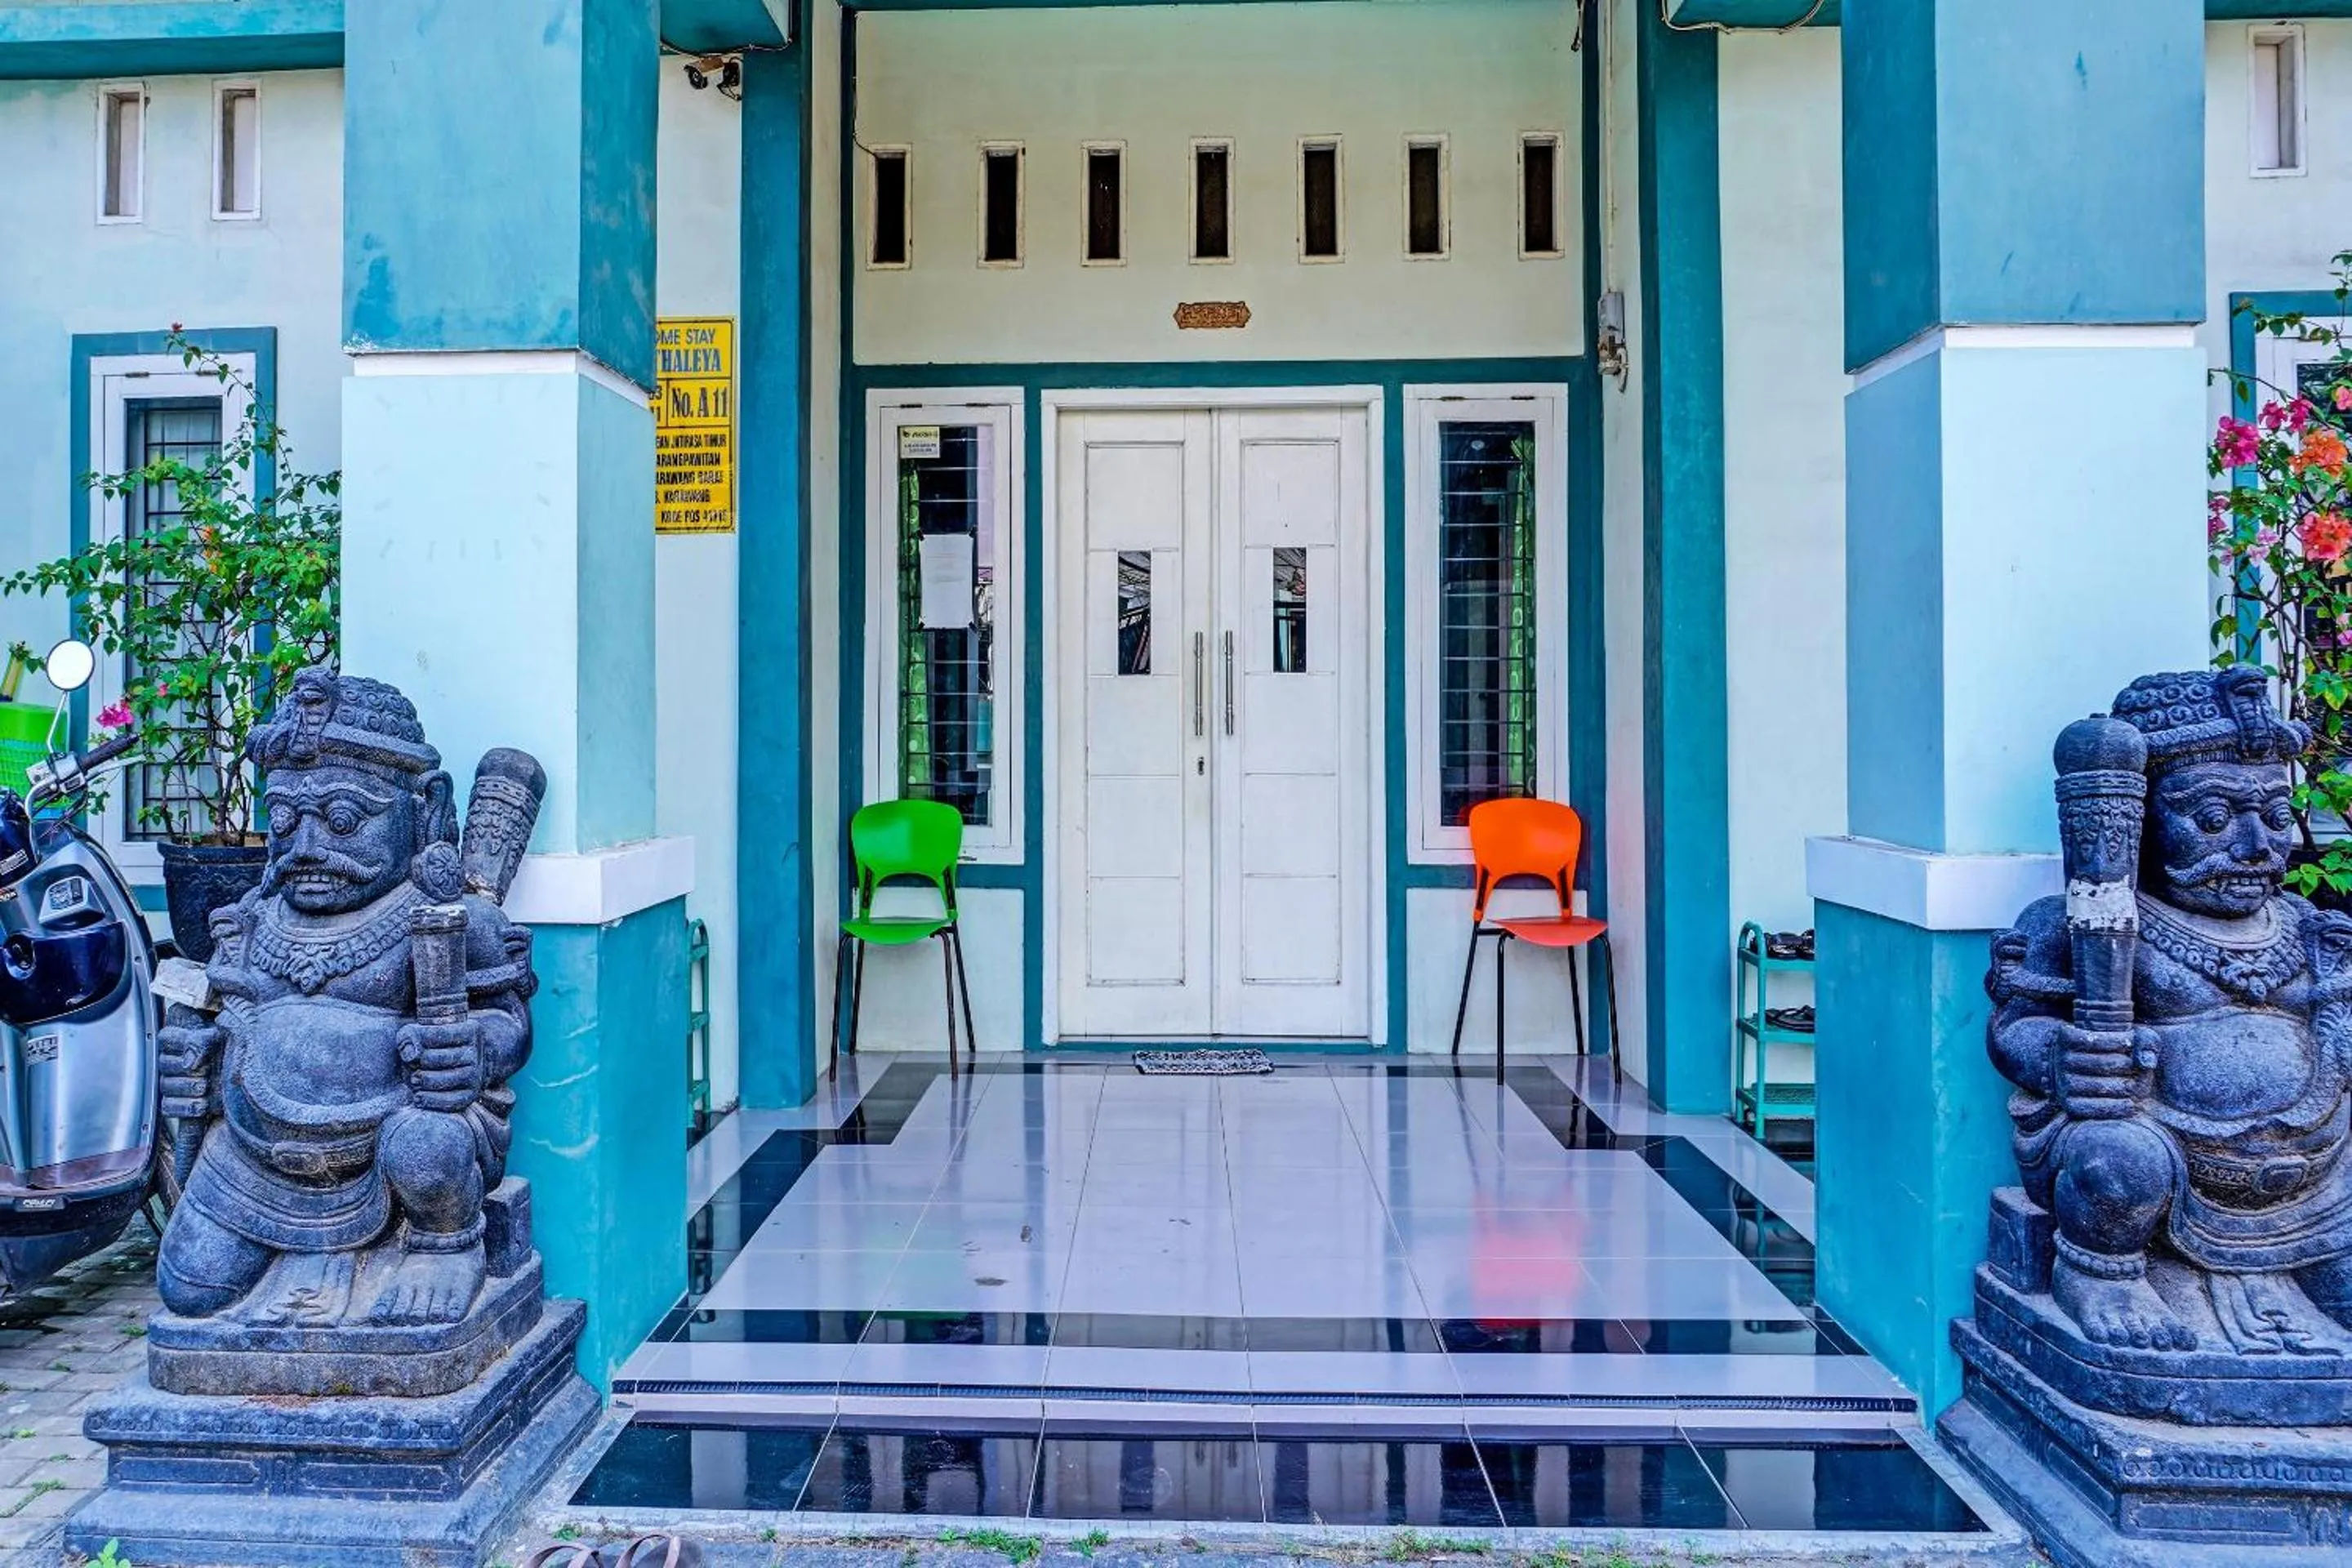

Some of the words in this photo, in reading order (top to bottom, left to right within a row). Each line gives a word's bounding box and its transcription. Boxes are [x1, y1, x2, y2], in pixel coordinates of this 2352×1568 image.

[686, 328, 715, 345] STAY
[657, 349, 722, 372] HALEYA
[671, 388, 694, 418] No.
[684, 509, 700, 523] POS
